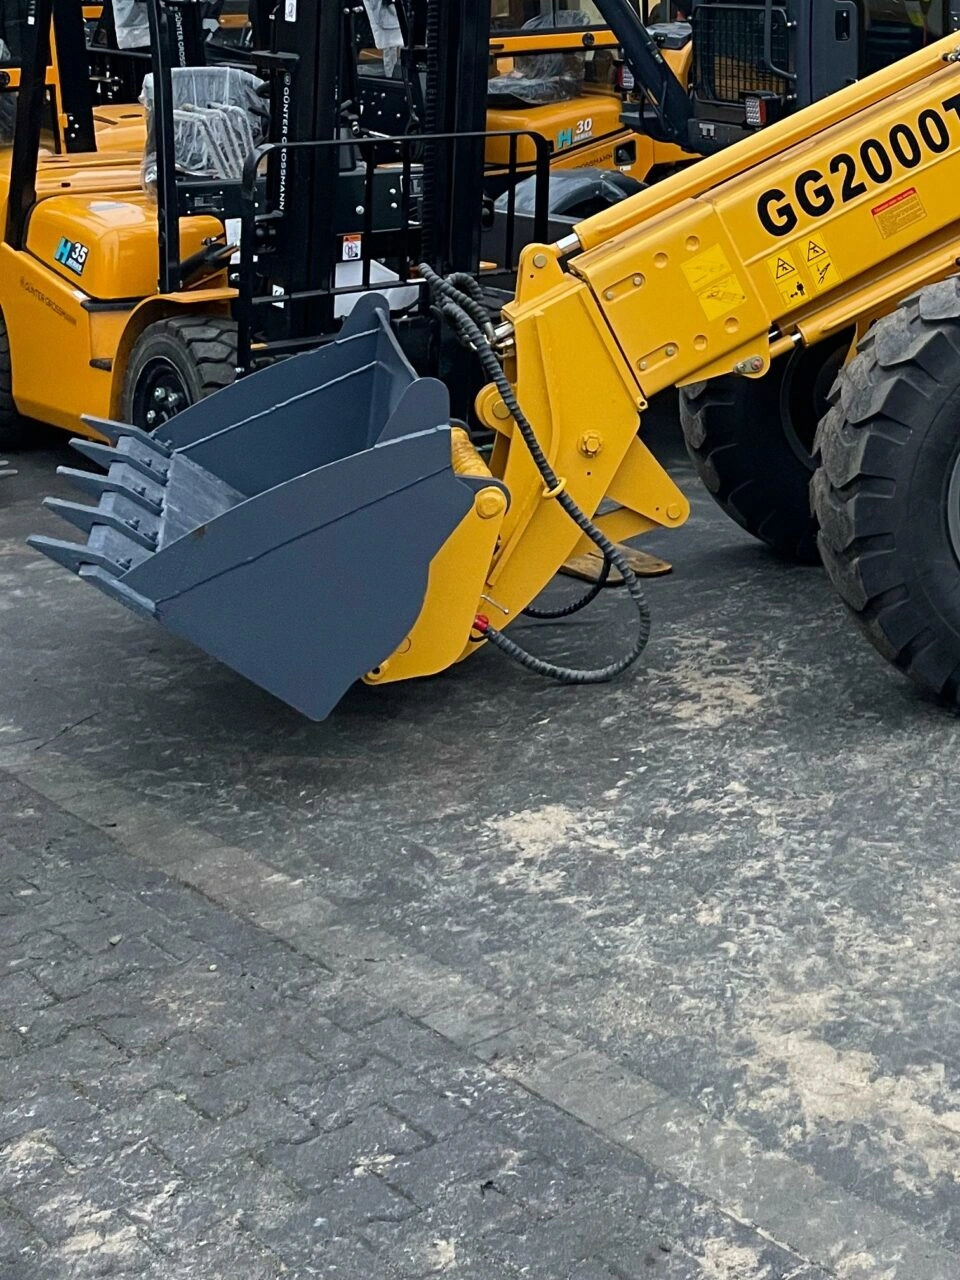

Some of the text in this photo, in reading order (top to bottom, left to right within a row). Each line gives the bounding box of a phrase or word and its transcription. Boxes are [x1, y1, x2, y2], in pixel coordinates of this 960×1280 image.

[281, 86, 291, 134] GÜNTER
[557, 118, 593, 150] H 30
[54, 236, 88, 265] H 35
